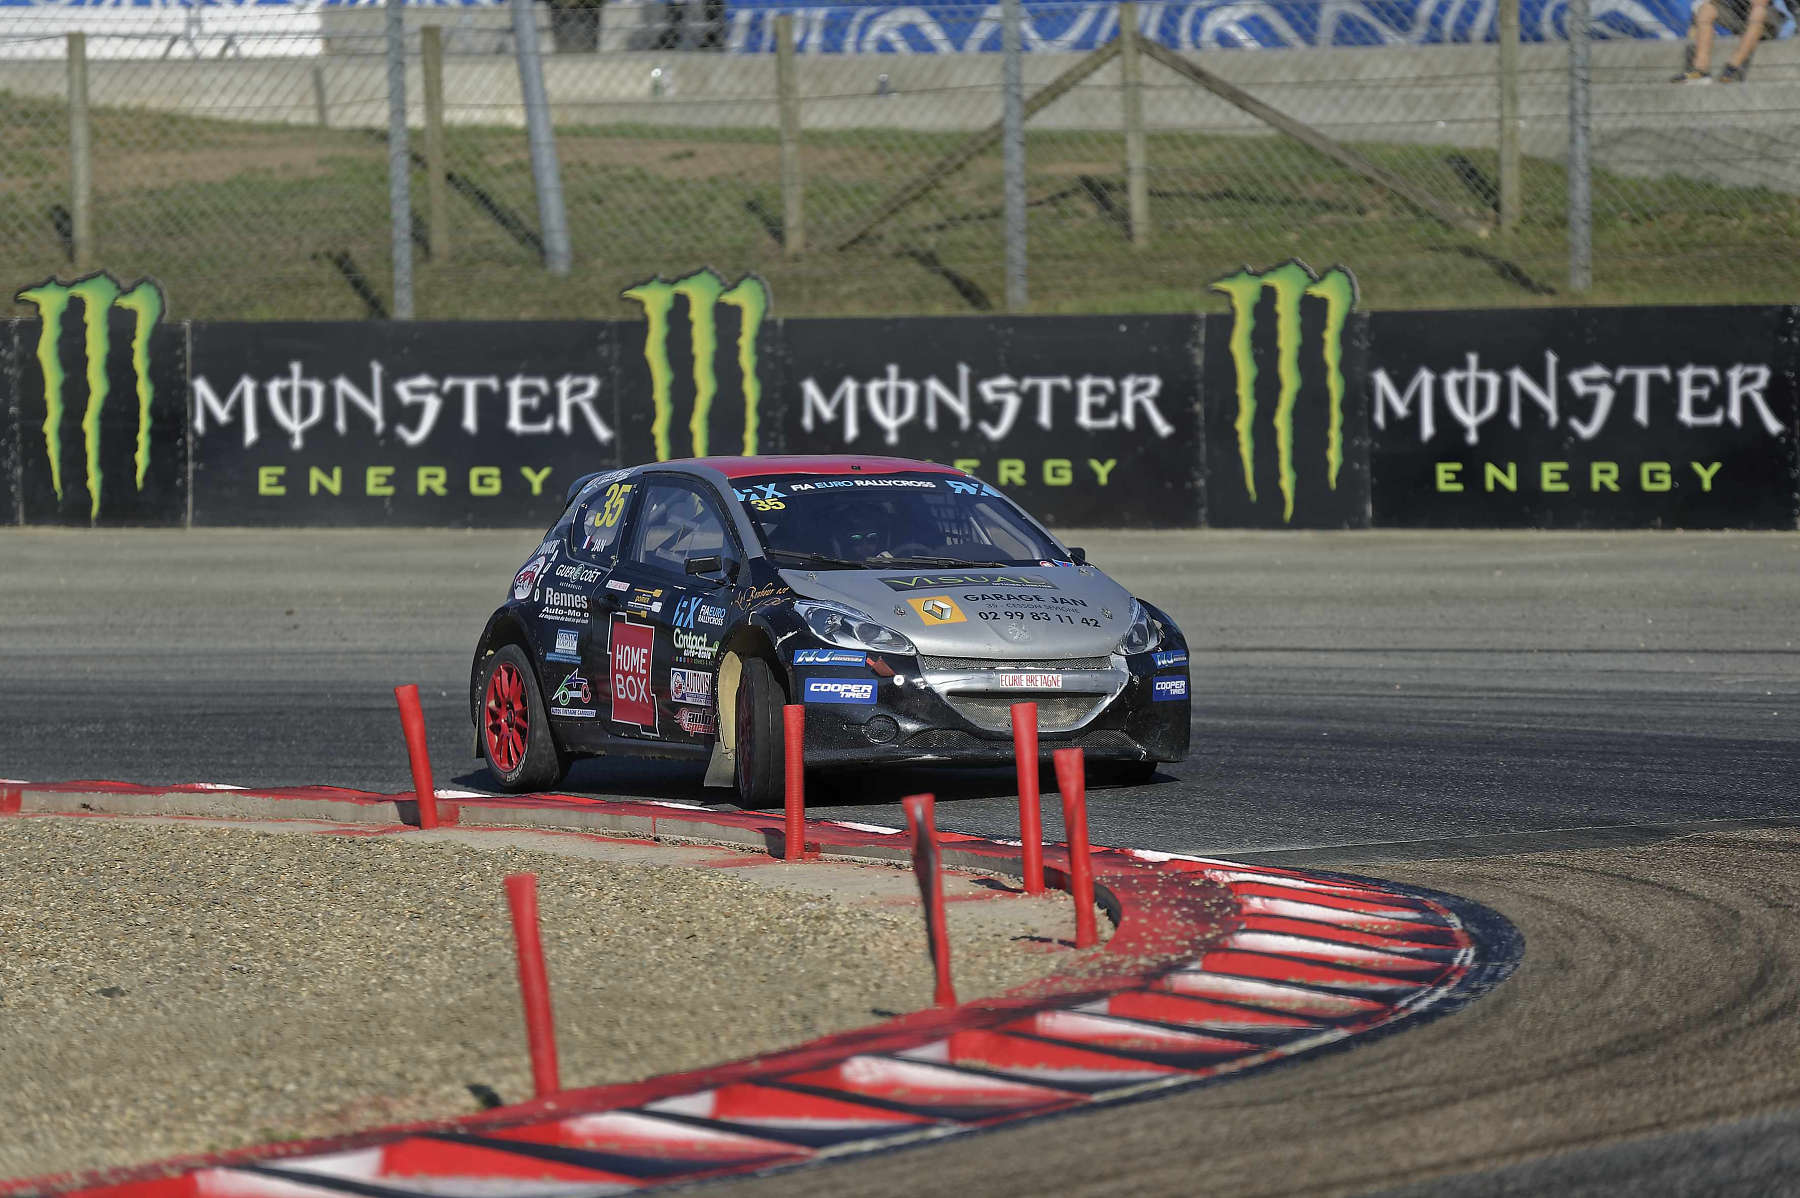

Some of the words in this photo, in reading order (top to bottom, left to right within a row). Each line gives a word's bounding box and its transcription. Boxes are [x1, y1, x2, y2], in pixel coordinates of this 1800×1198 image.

[192, 360, 614, 449] MONSTER
[800, 362, 1175, 445] MONSTER
[1370, 350, 1786, 444] MONSTER
[952, 458, 1117, 486] ERGY
[1435, 462, 1723, 492] ENERGY
[257, 465, 553, 497] ENERGY
[790, 482, 815, 492] FIA
[815, 480, 854, 489] EURO
[854, 479, 937, 488] RALLYCROSS
[594, 483, 632, 527] 35
[750, 498, 786, 512] 35
[591, 538, 606, 552] JAN
[885, 575, 1046, 587] VISUAL
[545, 587, 588, 609] Rennes
[963, 593, 1046, 602] GARAGE
[1051, 596, 1088, 607] JAN
[542, 606, 590, 618] Auto-Moo
[978, 611, 1000, 621] 02
[1004, 611, 1025, 620] 99
[1030, 612, 1051, 621] 83
[1056, 614, 1074, 625] 11
[1081, 617, 1101, 628] 42
[697, 615, 724, 627] RALLYCROSS
[673, 628, 709, 651] Contact
[615, 643, 648, 674] HOME
[615, 673, 649, 704] BOX
[809, 683, 873, 694] COOPER
[1000, 674, 1025, 687] ECURIE
[1026, 674, 1061, 688] BRETAGNE
[1155, 681, 1186, 690] COOPER
[840, 691, 871, 699] TIRES
